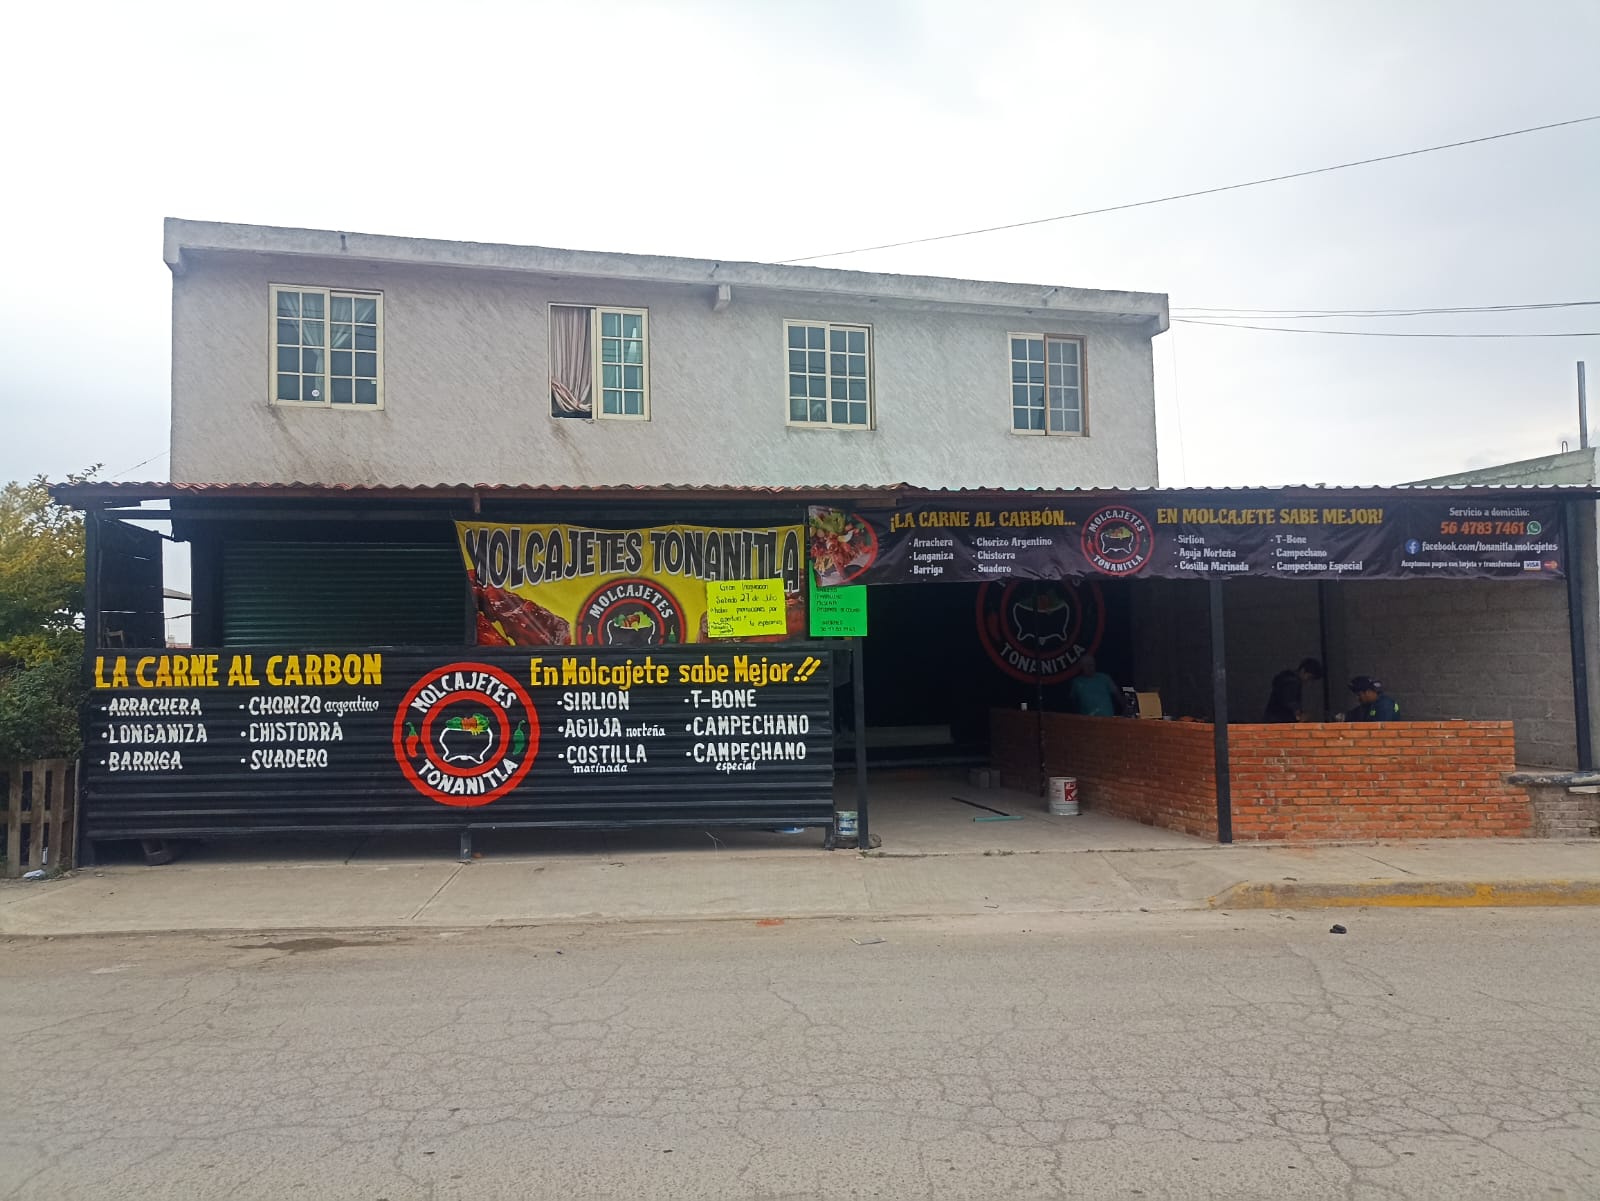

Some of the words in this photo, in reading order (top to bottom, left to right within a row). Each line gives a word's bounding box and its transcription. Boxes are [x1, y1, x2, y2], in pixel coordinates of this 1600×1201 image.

[890, 512, 915, 532] ¡LA
[919, 511, 969, 528] CARNE
[975, 511, 995, 527] AL
[999, 507, 1076, 527] CARBÓN...
[1157, 508, 1178, 524] EN
[1182, 507, 1275, 525] MOLCAJETE
[1280, 508, 1318, 525] SABE
[1322, 507, 1383, 525] MEJOR!
[1449, 507, 1482, 516] Servicio
[1491, 507, 1530, 516] domicilio:
[1088, 510, 1145, 532] MOLCAJETES
[1440, 521, 1457, 534] 56
[1461, 521, 1492, 535] 4783
[1495, 521, 1524, 535] 7461
[913, 538, 953, 547] Arrachera
[976, 537, 1009, 547] Chorizo
[1011, 536, 1053, 548] Argentino
[1178, 535, 1205, 544] Sirlion
[1275, 535, 1307, 544] T-Bone
[465, 527, 642, 589] MOLCAJETES
[650, 529, 800, 592] TONANITLA
[913, 551, 954, 562] Longaniza
[977, 550, 1016, 560] Chistorra
[1093, 554, 1144, 572] TONANITLA
[1179, 548, 1201, 560] Aguja
[1276, 548, 1327, 560] Campechano
[913, 565, 943, 576] Barriga
[977, 564, 1012, 573] Suadero
[1180, 561, 1208, 570] Costilla
[1211, 562, 1249, 571] Marinada
[1277, 561, 1327, 573] Campechano
[1329, 560, 1363, 573] Especial
[590, 585, 674, 618] MOLCAJETES
[94, 656, 128, 688] LA
[136, 655, 219, 688] CARNE
[228, 654, 260, 686] AL
[266, 654, 382, 686] CARBON
[530, 657, 558, 686] En
[562, 656, 670, 691] Molcajete
[679, 655, 729, 684] sabe
[410, 672, 517, 713] MOLCAJETES
[564, 690, 630, 711] SIRLION
[690, 689, 757, 708] T-BONE
[108, 698, 202, 716] ARRACHERA
[248, 695, 322, 714] CHORIZO
[324, 696, 380, 717] argentino
[108, 723, 208, 744] LONGANIZA
[249, 722, 344, 742] CHISTORRA
[564, 718, 622, 738] AGUJA
[625, 722, 666, 737] norteña
[693, 714, 809, 736] CAMPECHANO
[108, 750, 183, 772] BARRIGA
[250, 749, 328, 770] SUADERO
[566, 744, 648, 764] COSTILLA
[693, 742, 806, 762] CAMPECHANO
[418, 758, 519, 794] TONANITLA
[572, 762, 628, 774] marinada
[716, 760, 756, 774] especial
